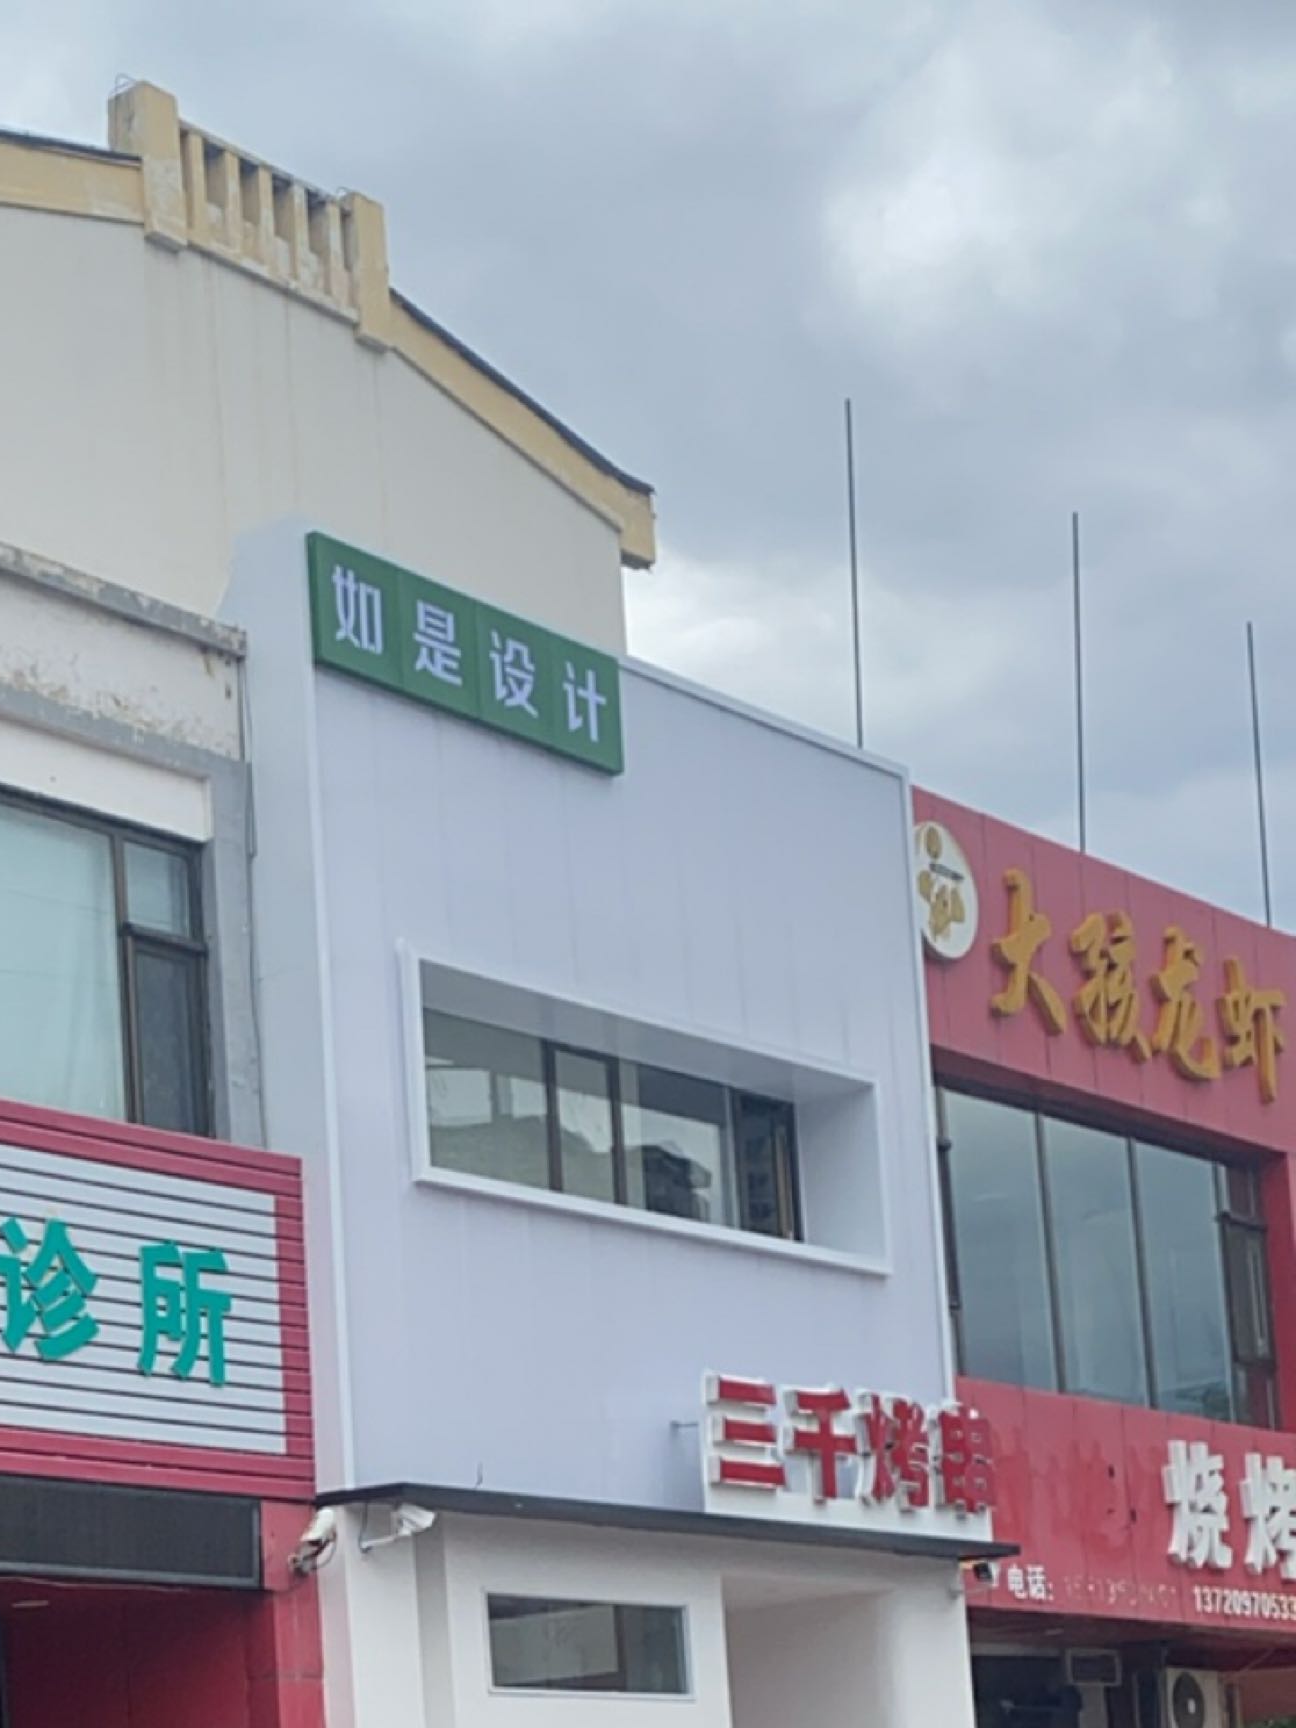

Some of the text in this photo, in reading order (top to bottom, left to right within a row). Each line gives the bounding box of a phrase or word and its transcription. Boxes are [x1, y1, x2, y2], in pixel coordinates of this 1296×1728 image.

[332, 564, 606, 742] 如是设计
[705, 1377, 995, 1513] 三千烤串
[1161, 1439, 1296, 1580] 烧烤
